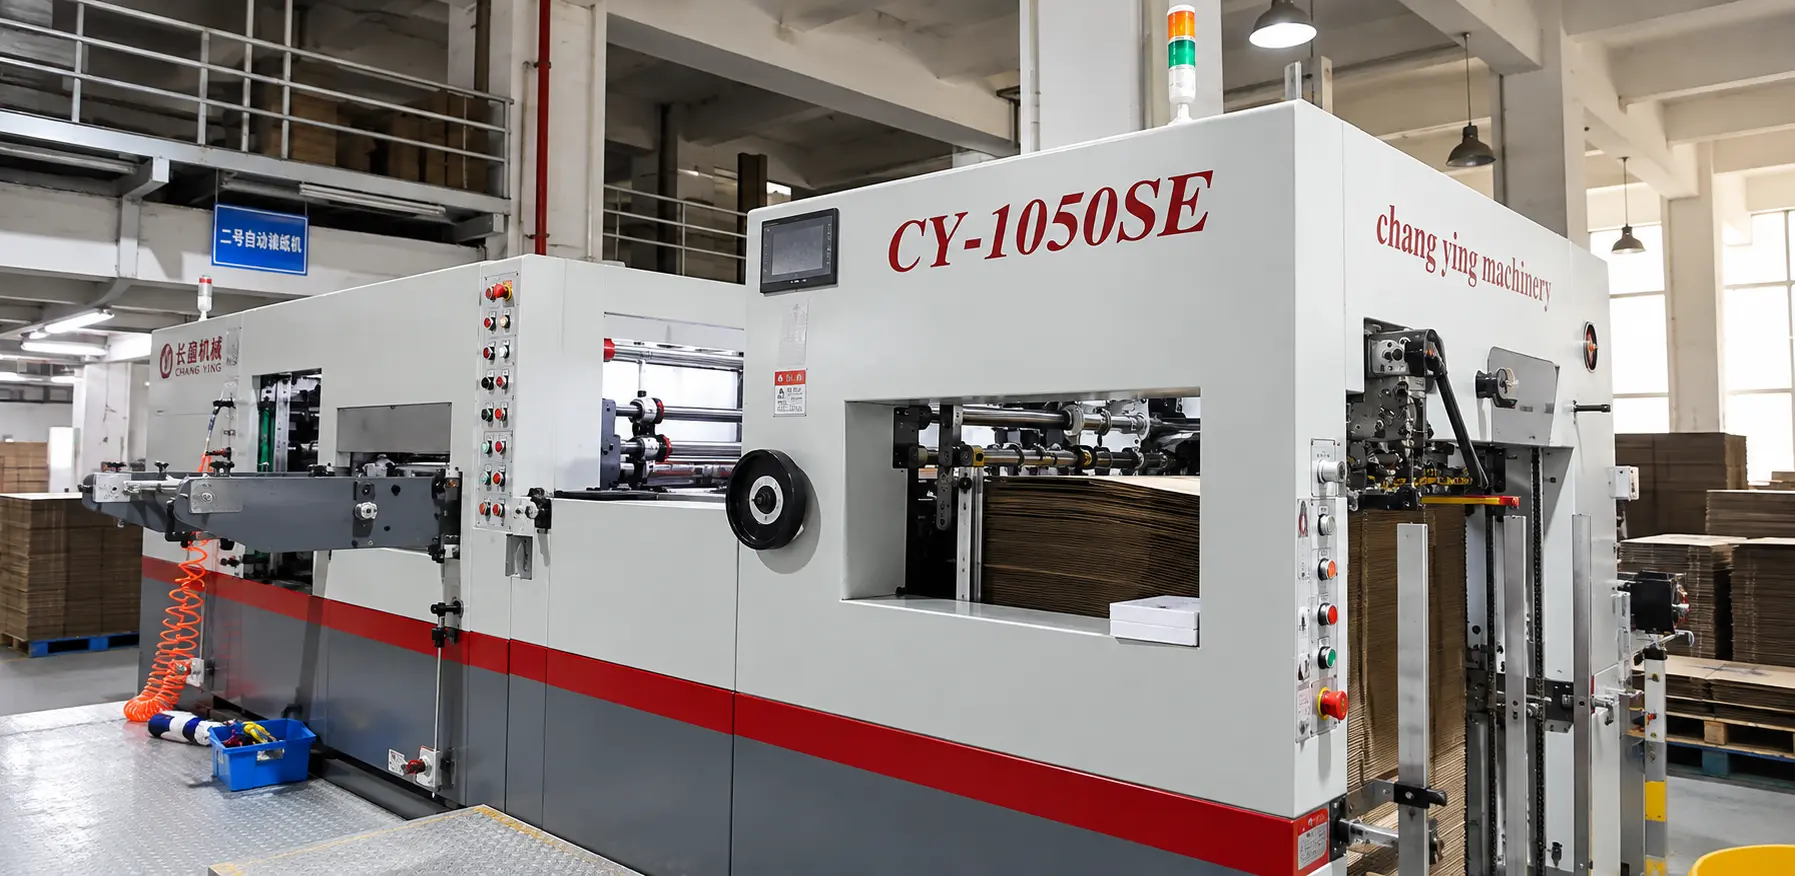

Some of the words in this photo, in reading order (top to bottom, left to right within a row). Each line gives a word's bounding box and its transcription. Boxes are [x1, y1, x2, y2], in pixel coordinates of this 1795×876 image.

[888, 170, 1214, 273] CY-1050SE
[1376, 205, 1437, 273] chang
[1441, 231, 1478, 287] ying
[1482, 256, 1552, 312] machinery
[175, 366, 200, 376] CHANG
[203, 363, 222, 373] YING
